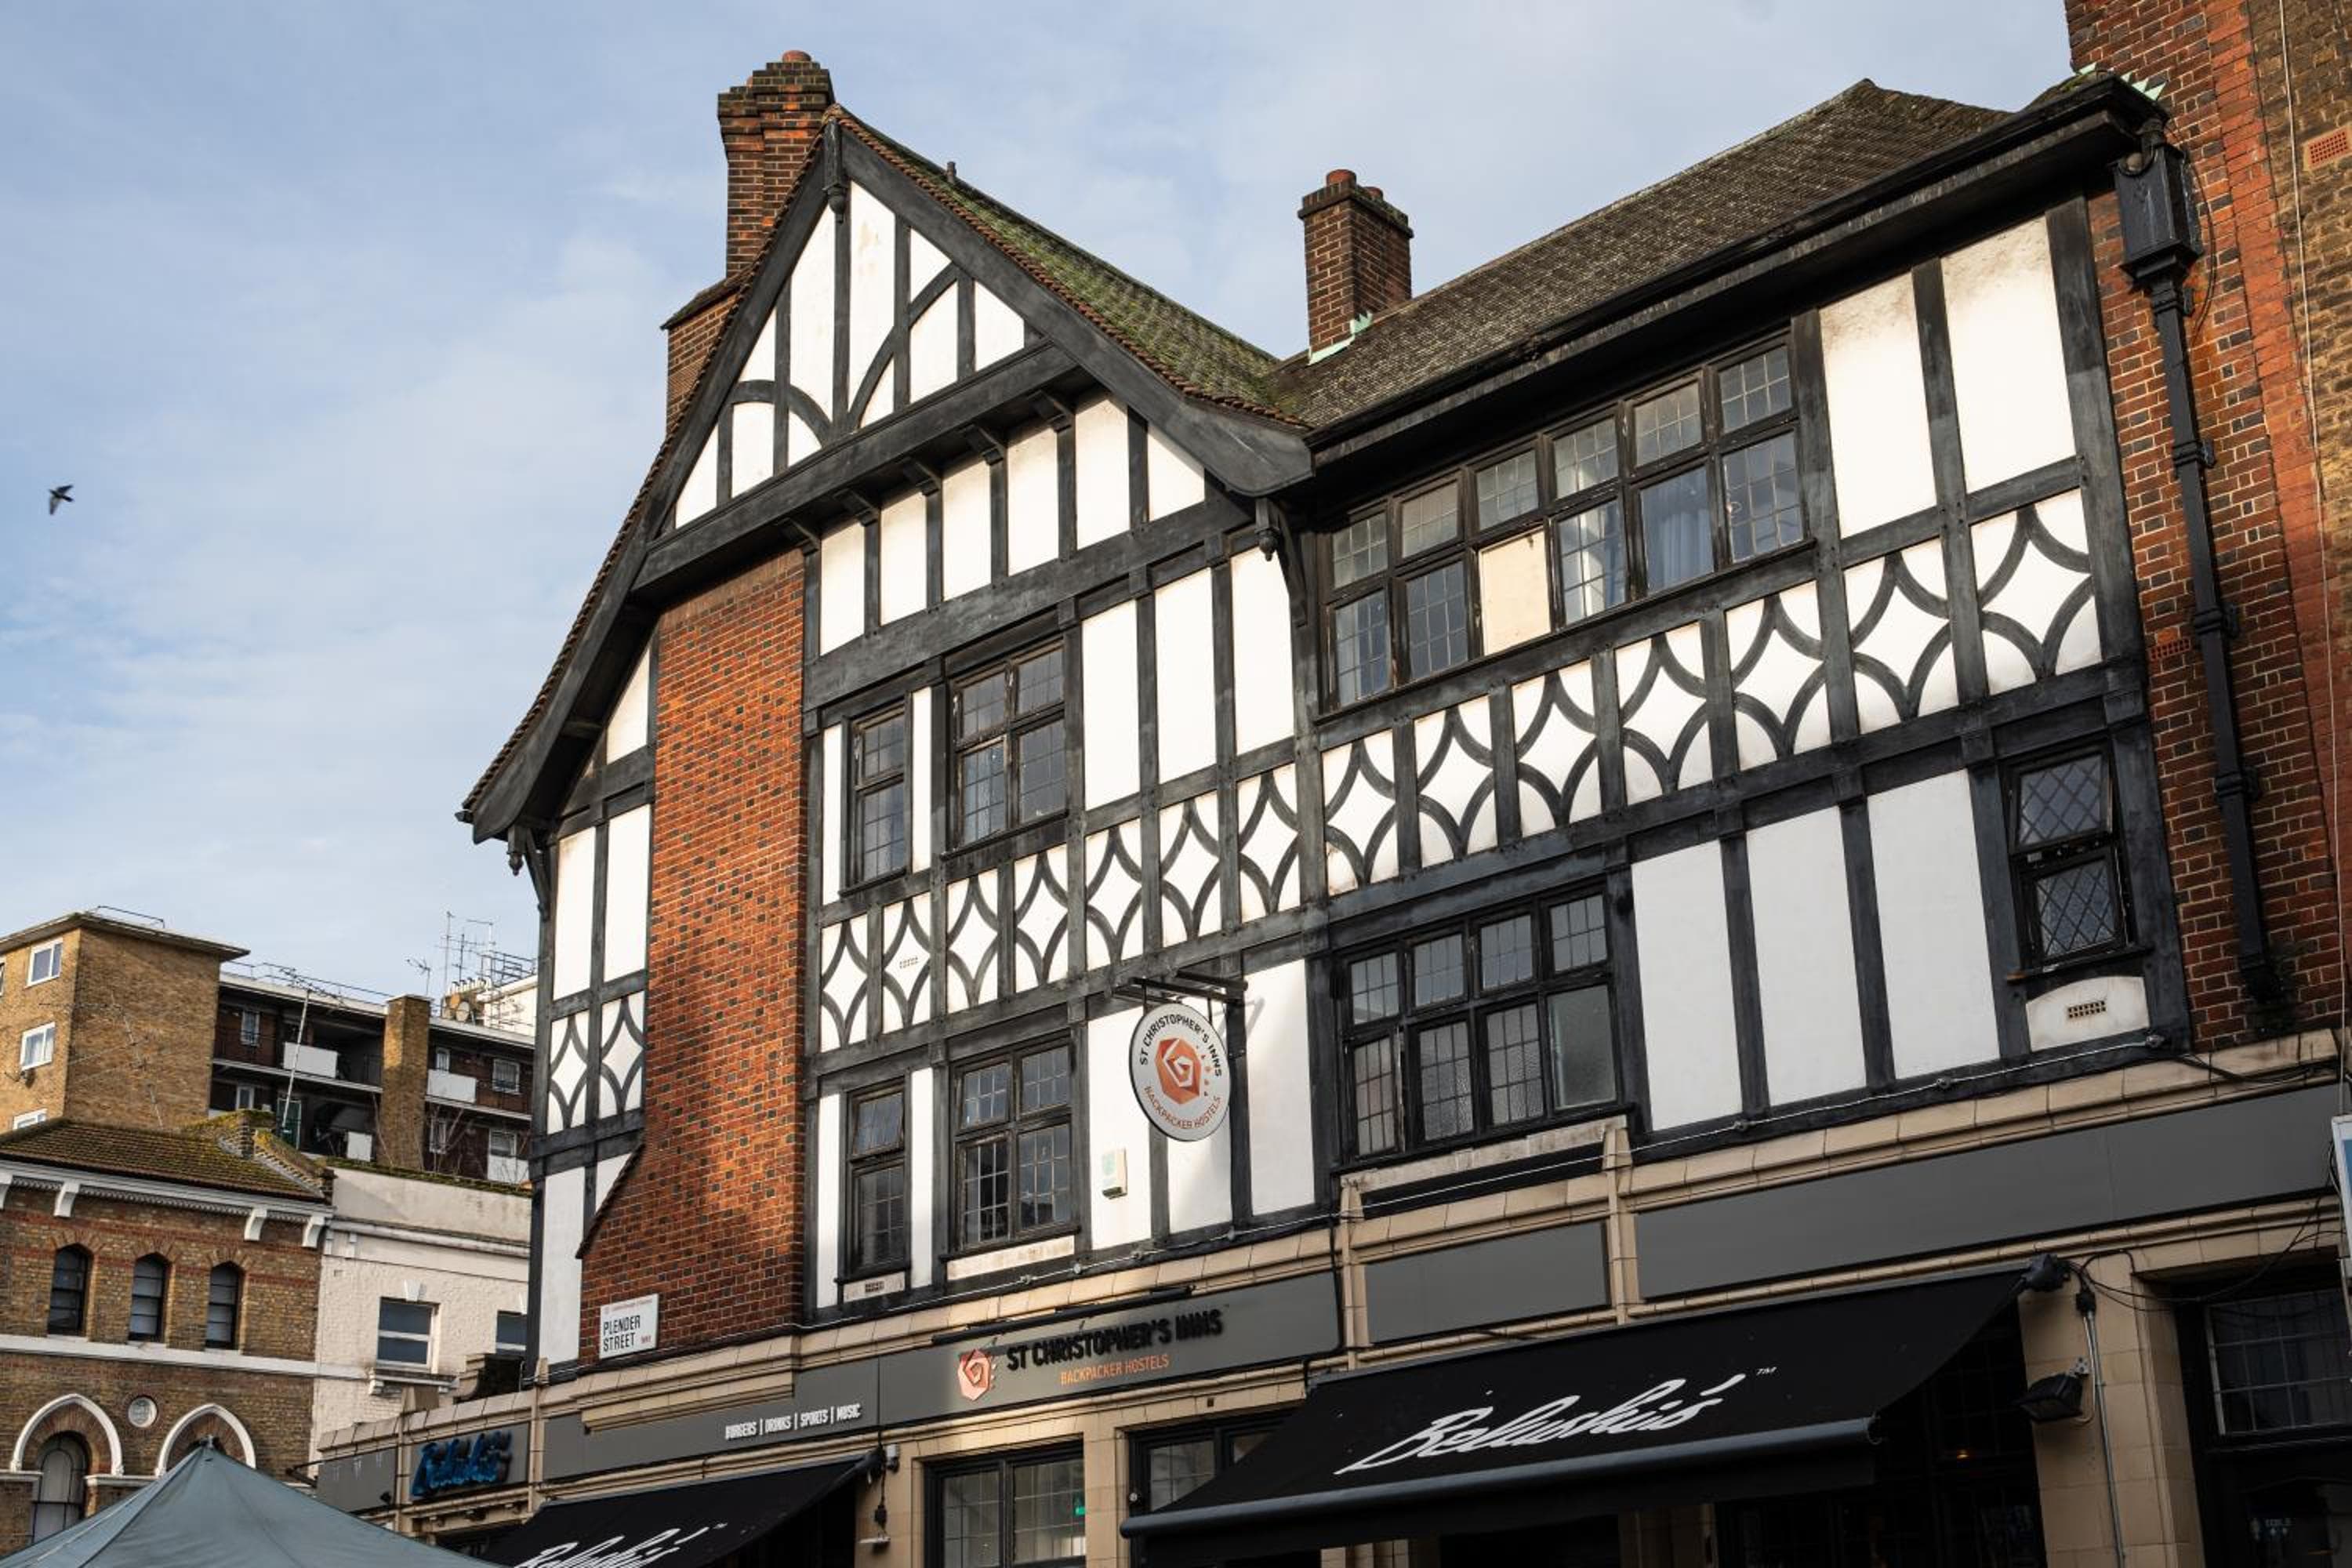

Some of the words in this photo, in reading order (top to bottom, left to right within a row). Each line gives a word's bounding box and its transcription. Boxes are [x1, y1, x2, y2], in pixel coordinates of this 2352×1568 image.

[1142, 1014, 1209, 1044] CHRISTOPHER'S
[1139, 1047, 1149, 1065] ST
[1208, 1044, 1222, 1077] INNS
[1144, 1085, 1192, 1129] BACKPACKER
[1194, 1096, 1221, 1128] HOSTELS
[603, 1315, 641, 1336] PLENDER
[1007, 1345, 1029, 1371] ST
[1032, 1318, 1173, 1368] CHRISTOPHER'S
[1176, 1308, 1224, 1341] INNS
[603, 1332, 636, 1352] STREET
[1061, 1363, 1123, 1386] BACKPACKER
[1125, 1354, 1170, 1375] HOSTELS
[800, 1409, 829, 1427] SPORTS
